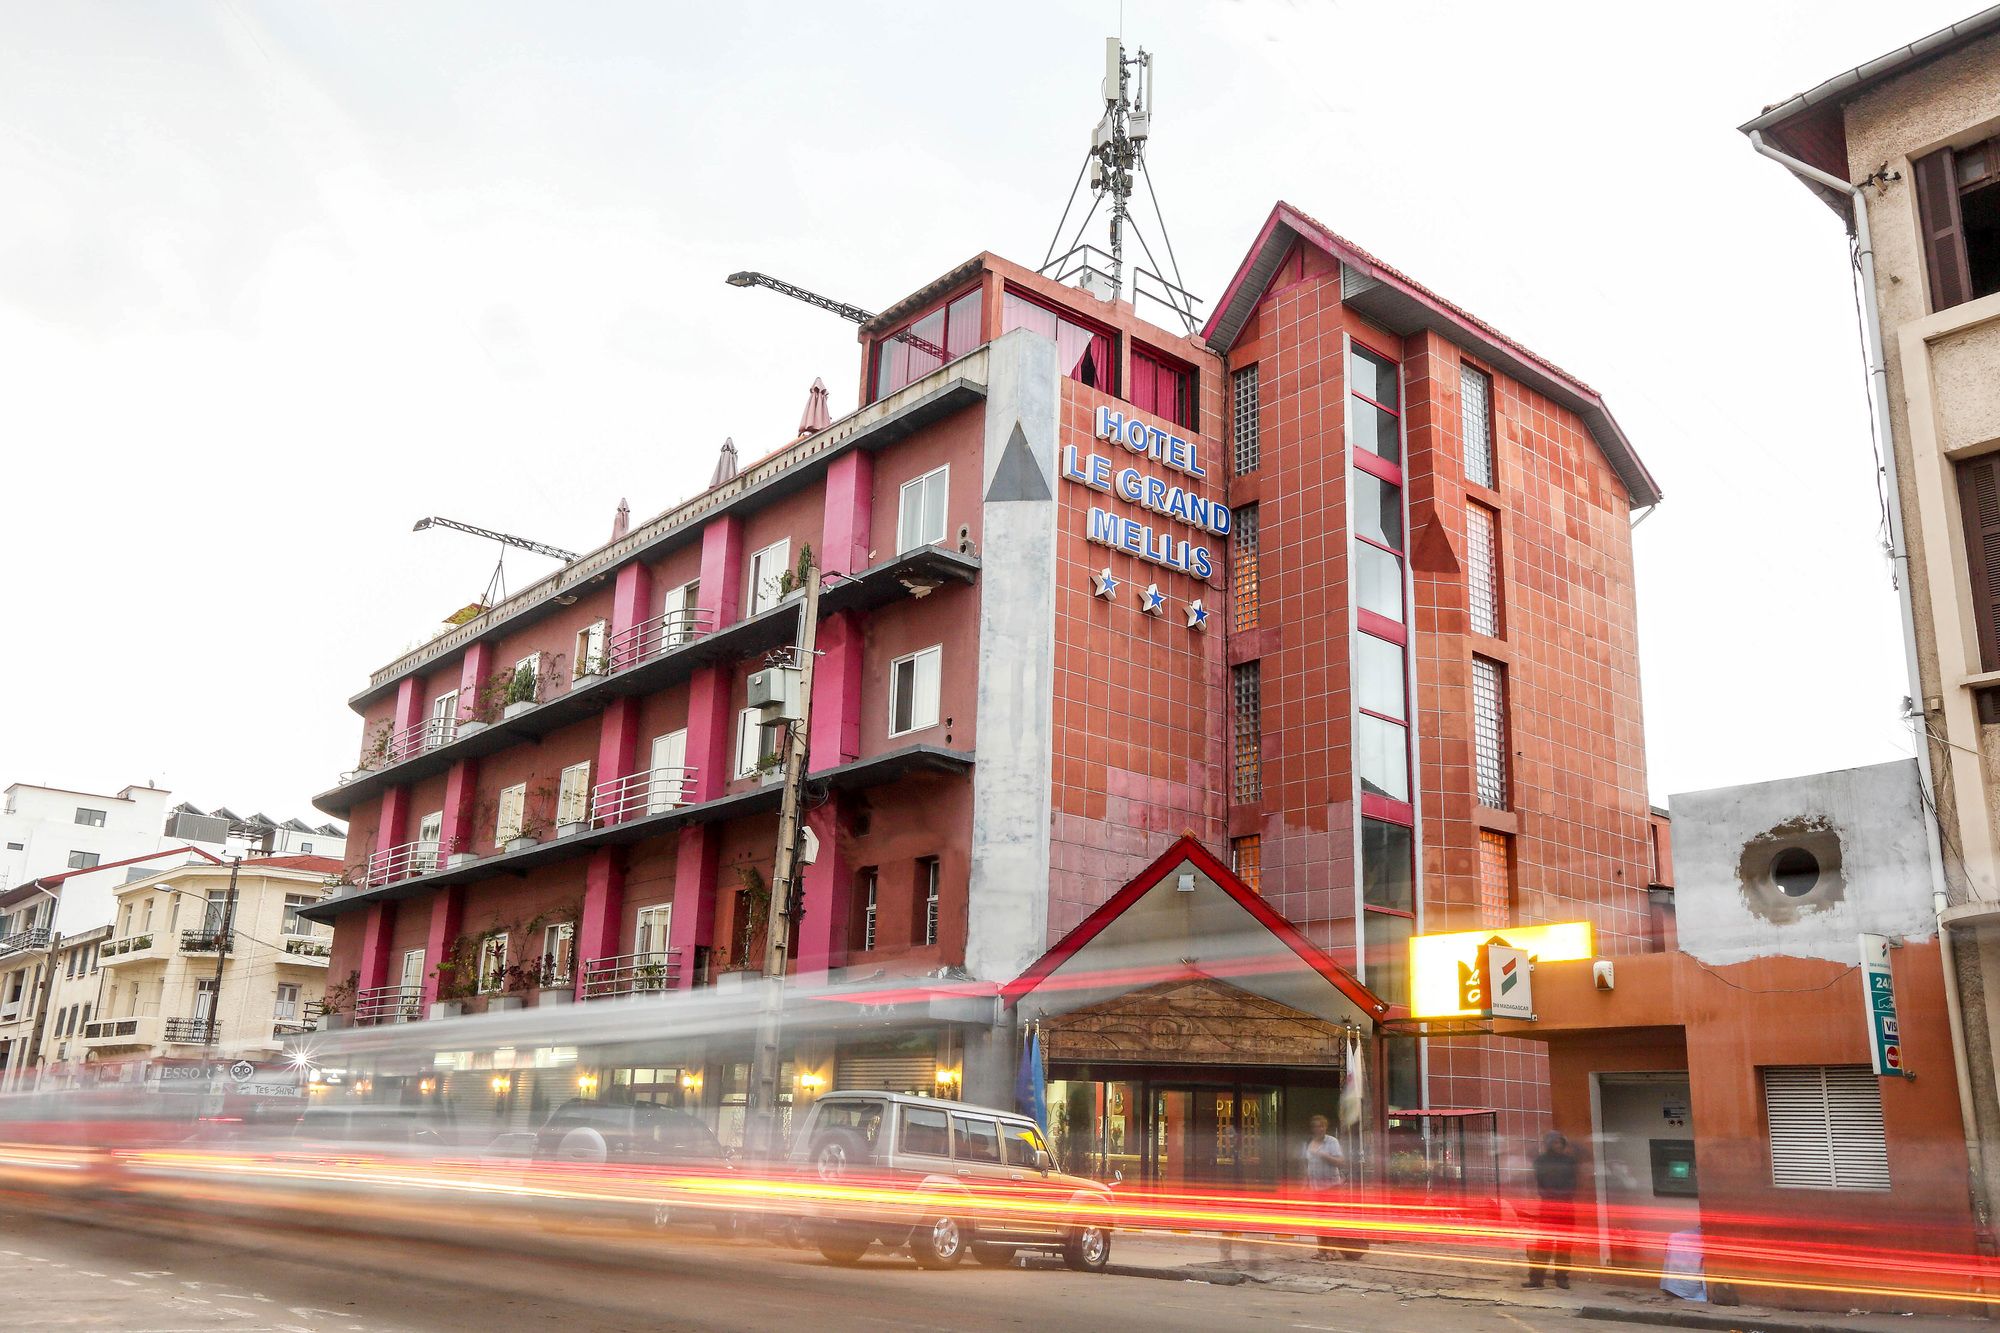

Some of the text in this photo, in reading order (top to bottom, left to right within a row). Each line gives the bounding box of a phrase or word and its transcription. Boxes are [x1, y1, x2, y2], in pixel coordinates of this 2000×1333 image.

[1096, 405, 1206, 480] HOTEL
[1063, 444, 1231, 537] LE GRAND
[1086, 507, 1213, 580] MELLIS
[1885, 1020, 1898, 1032] VIS
[255, 1085, 297, 1096] TEE-SHIRT
